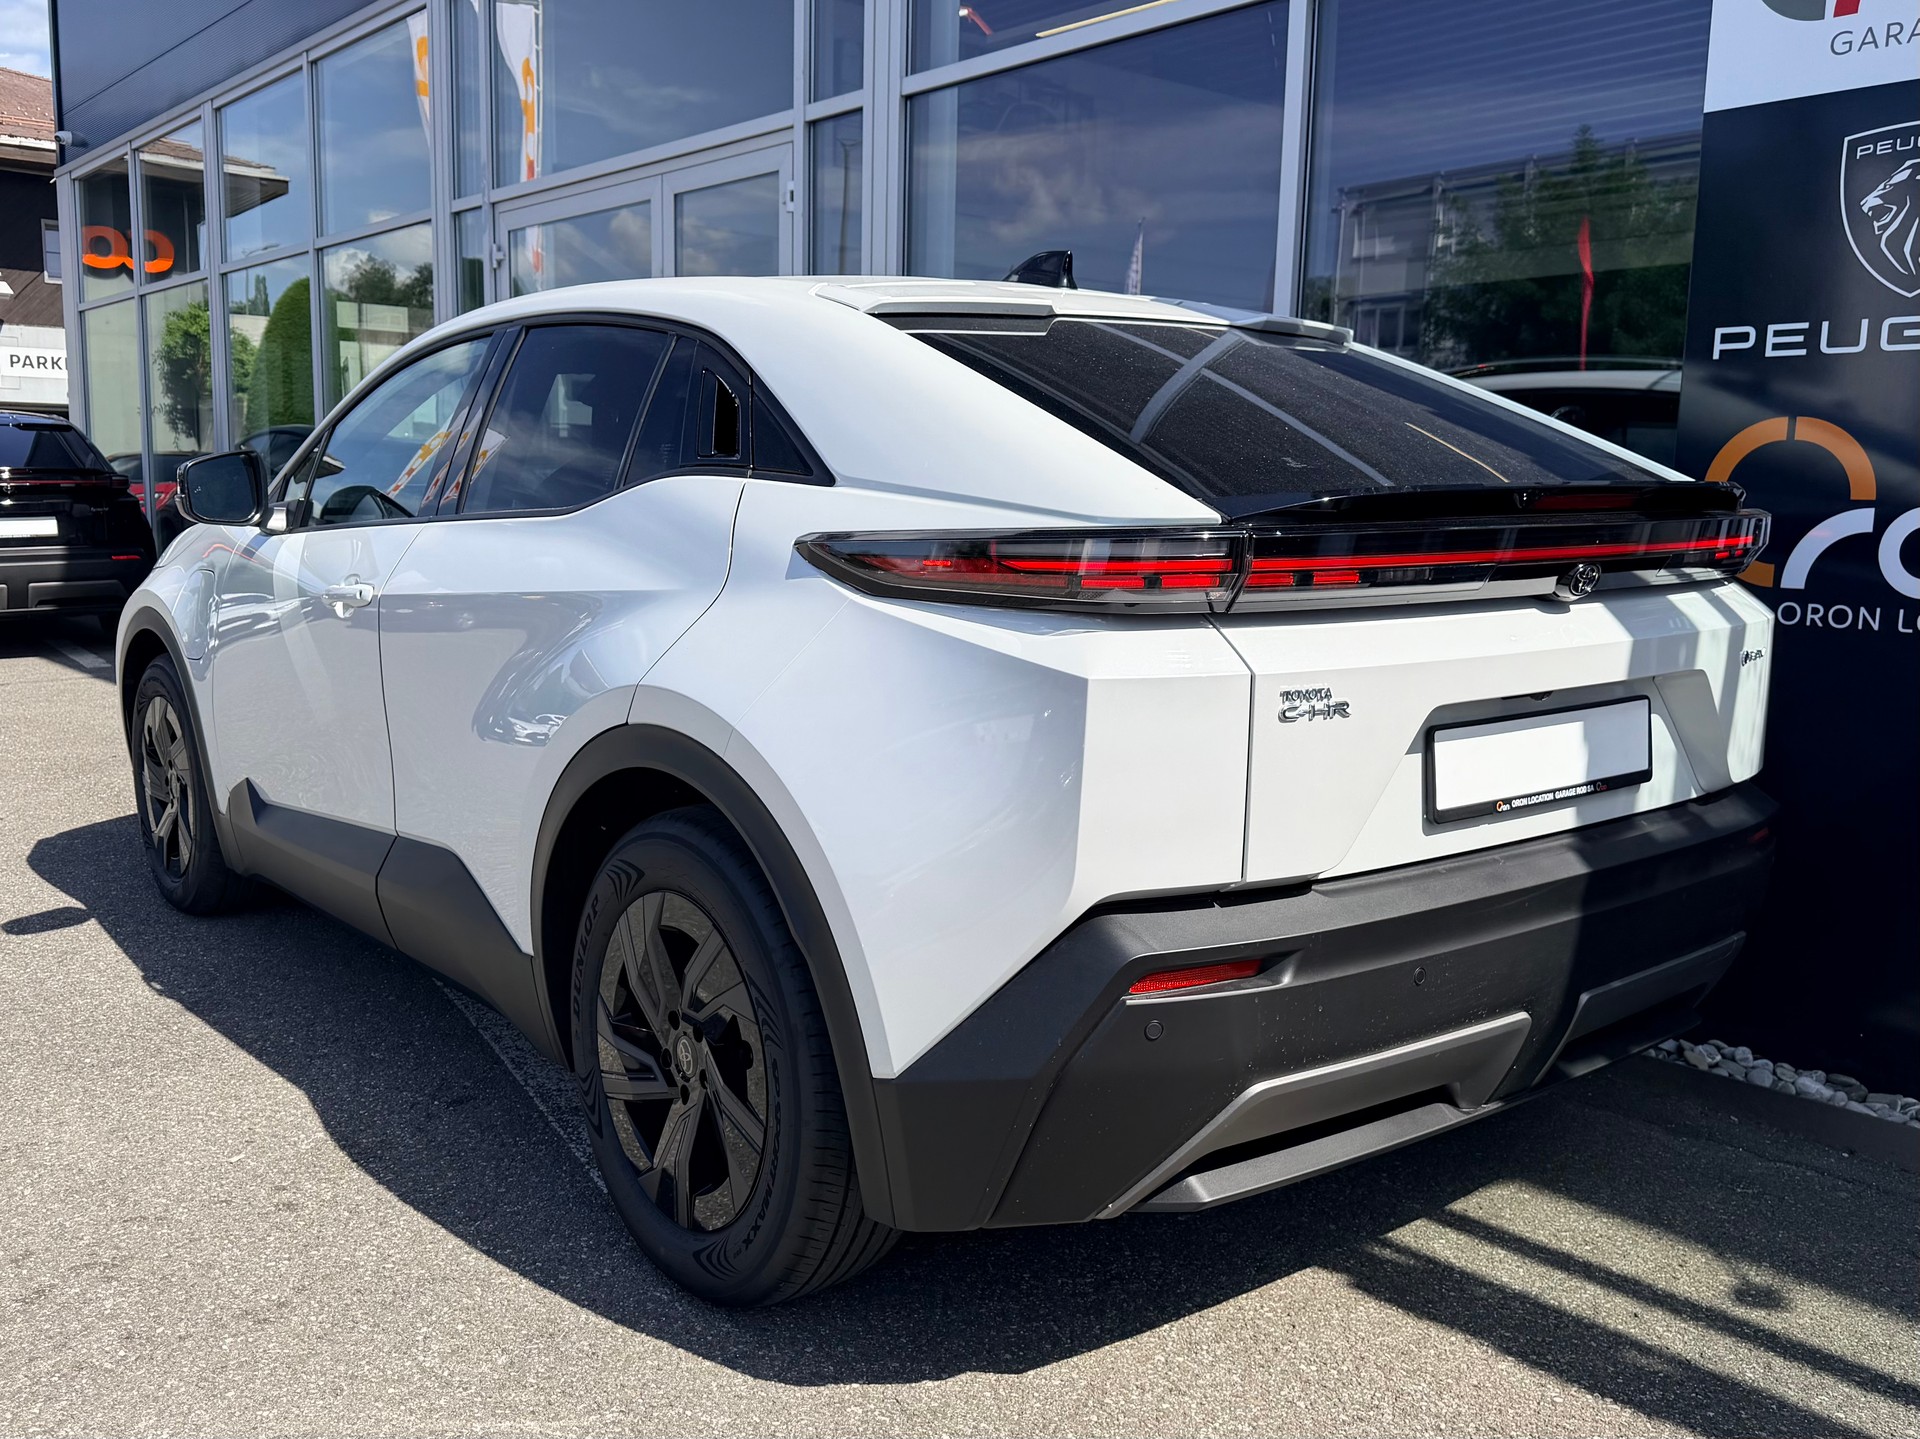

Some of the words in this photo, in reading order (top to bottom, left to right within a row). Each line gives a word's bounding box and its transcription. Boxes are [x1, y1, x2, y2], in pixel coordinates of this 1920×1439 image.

[1856, 133, 1920, 160] PEU
[1777, 601, 1881, 631] ORON
[1897, 608, 1920, 633] L
[1280, 687, 1333, 704] TOYOTA
[1278, 700, 1352, 723] C-HR
[574, 893, 599, 1023] DUNLOP
